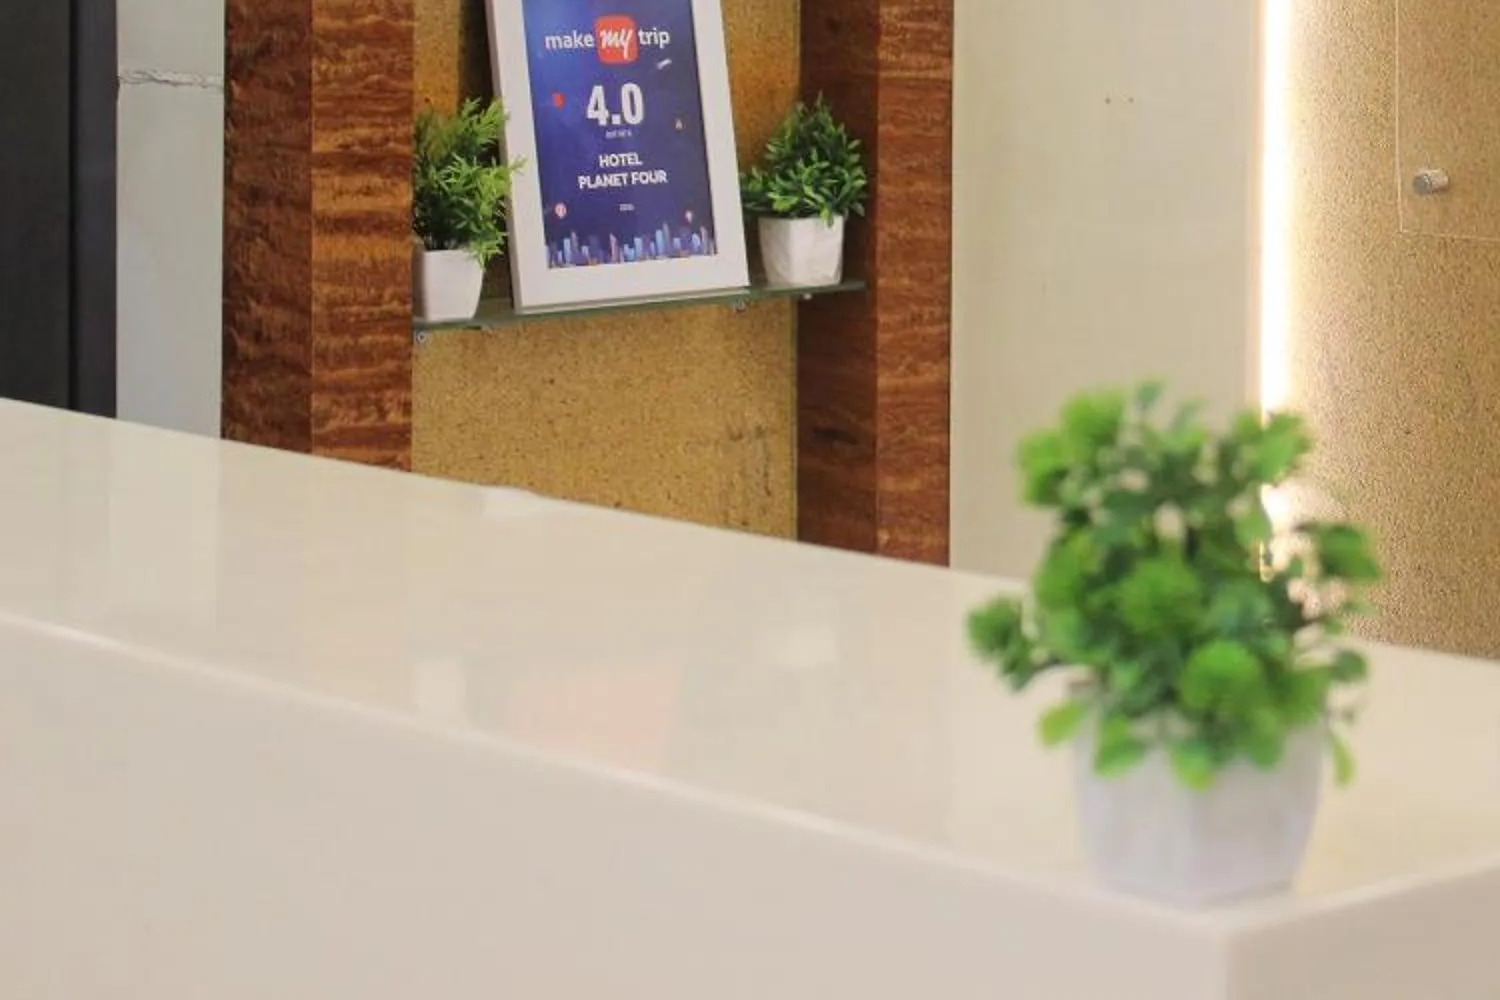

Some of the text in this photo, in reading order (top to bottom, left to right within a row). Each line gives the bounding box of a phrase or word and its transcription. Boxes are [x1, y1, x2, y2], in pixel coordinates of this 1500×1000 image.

[544, 27, 671, 60] make my trip
[586, 82, 644, 127] 4.0
[599, 152, 643, 168] HOTEL
[577, 169, 668, 190] PLANET FOUR
